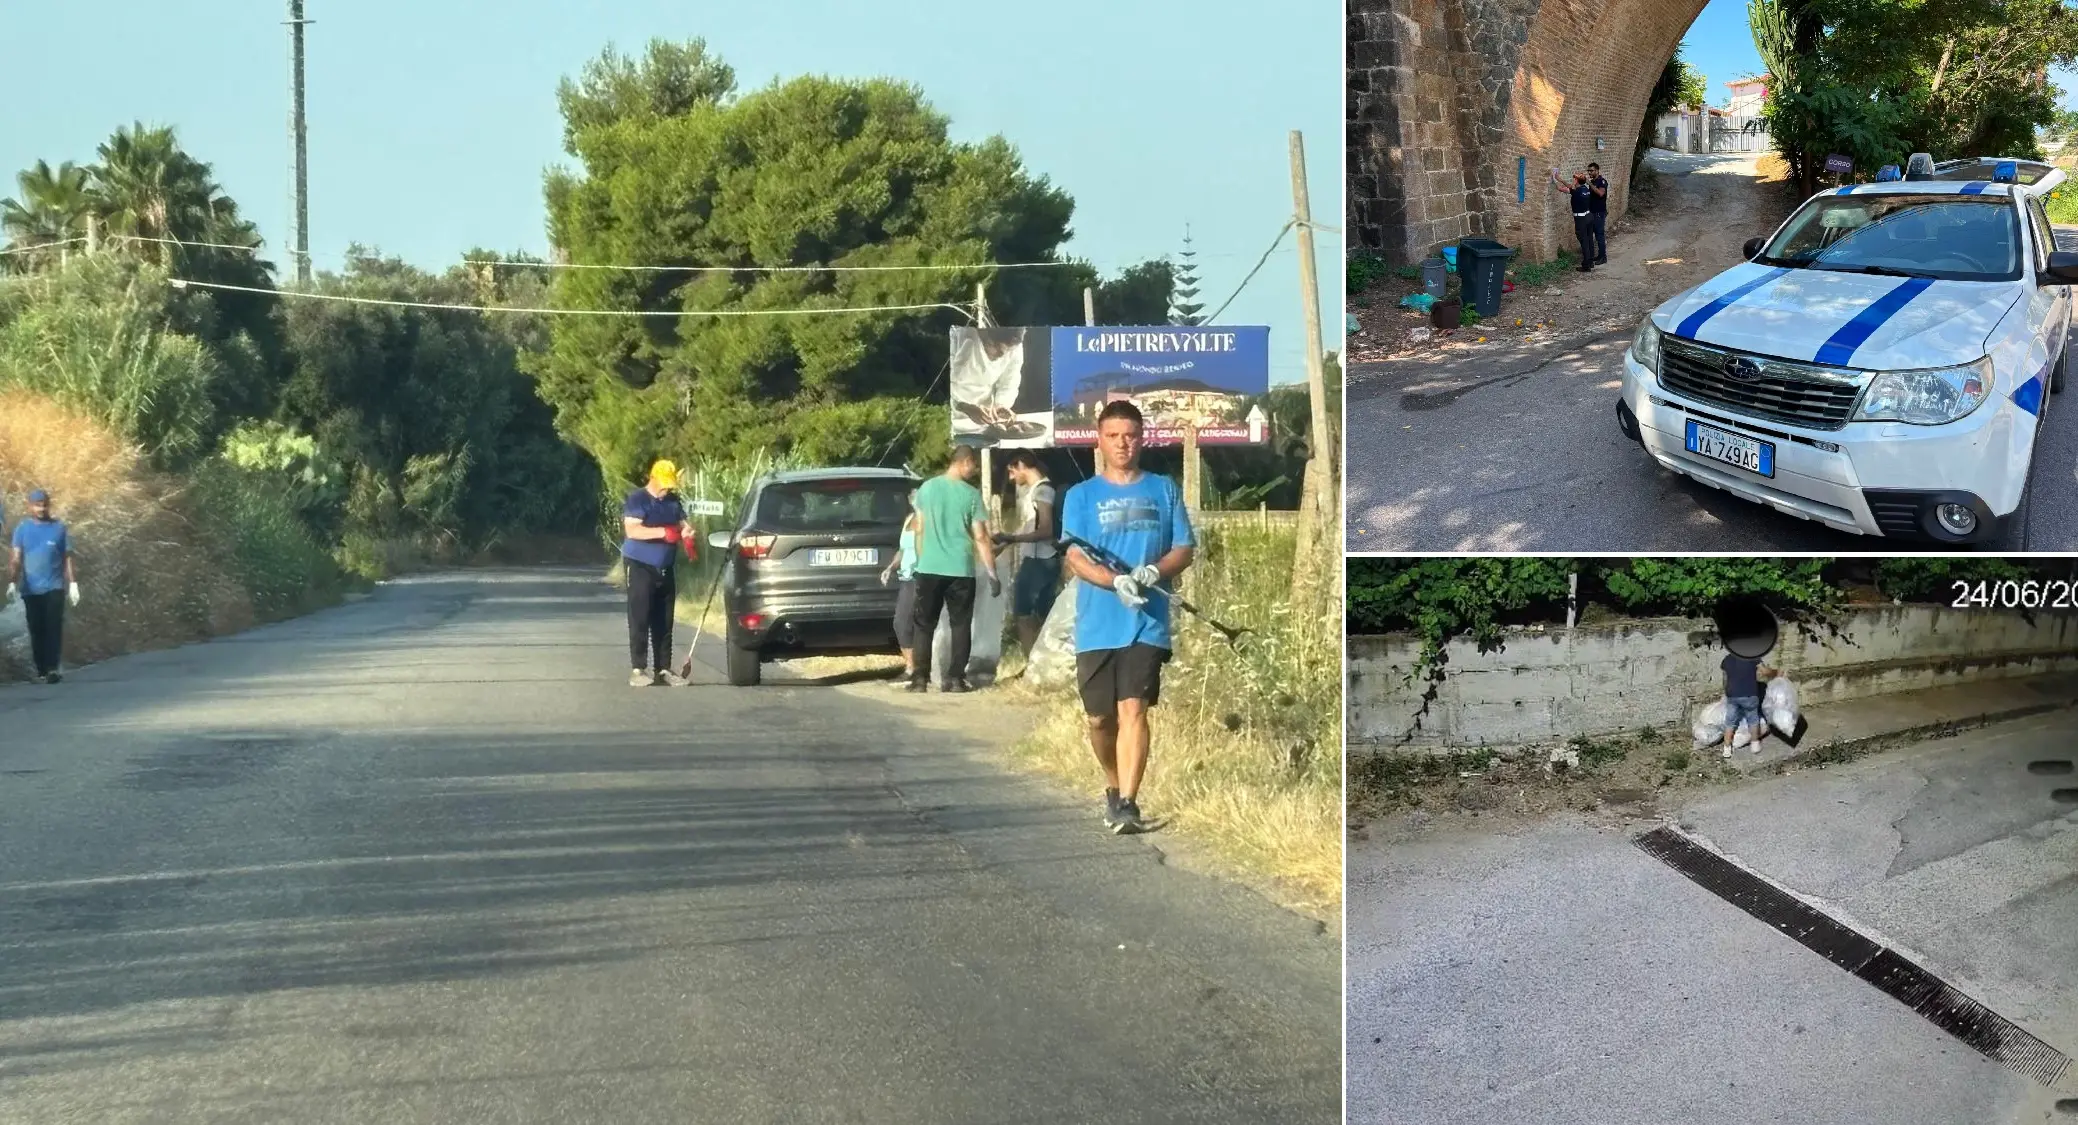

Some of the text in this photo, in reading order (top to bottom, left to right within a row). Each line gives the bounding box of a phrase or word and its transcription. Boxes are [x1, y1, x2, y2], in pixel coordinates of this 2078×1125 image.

[1698, 434, 1712, 455] YA
[1717, 441, 1759, 470] 749AG
[1701, 427, 1756, 452] POLIZIA LOCALE
